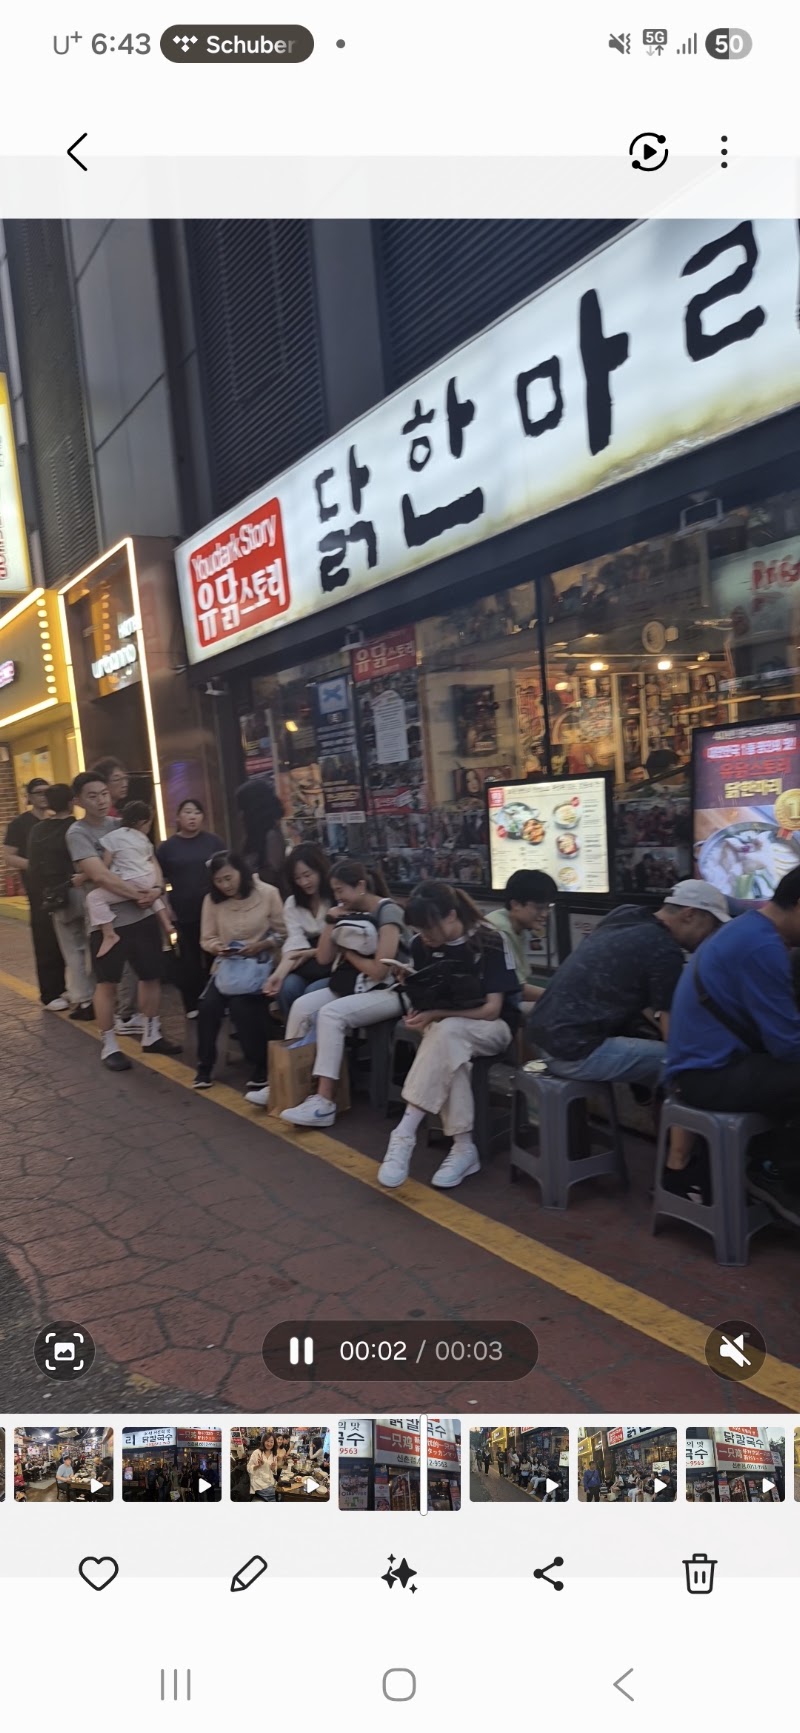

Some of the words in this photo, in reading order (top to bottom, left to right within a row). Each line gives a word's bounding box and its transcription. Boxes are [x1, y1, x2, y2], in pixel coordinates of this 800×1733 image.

[191, 533, 243, 582] Youdark
[239, 514, 277, 556] Story
[197, 557, 287, 641] 유닭스토리
[724, 778, 783, 799] 닭한마리
